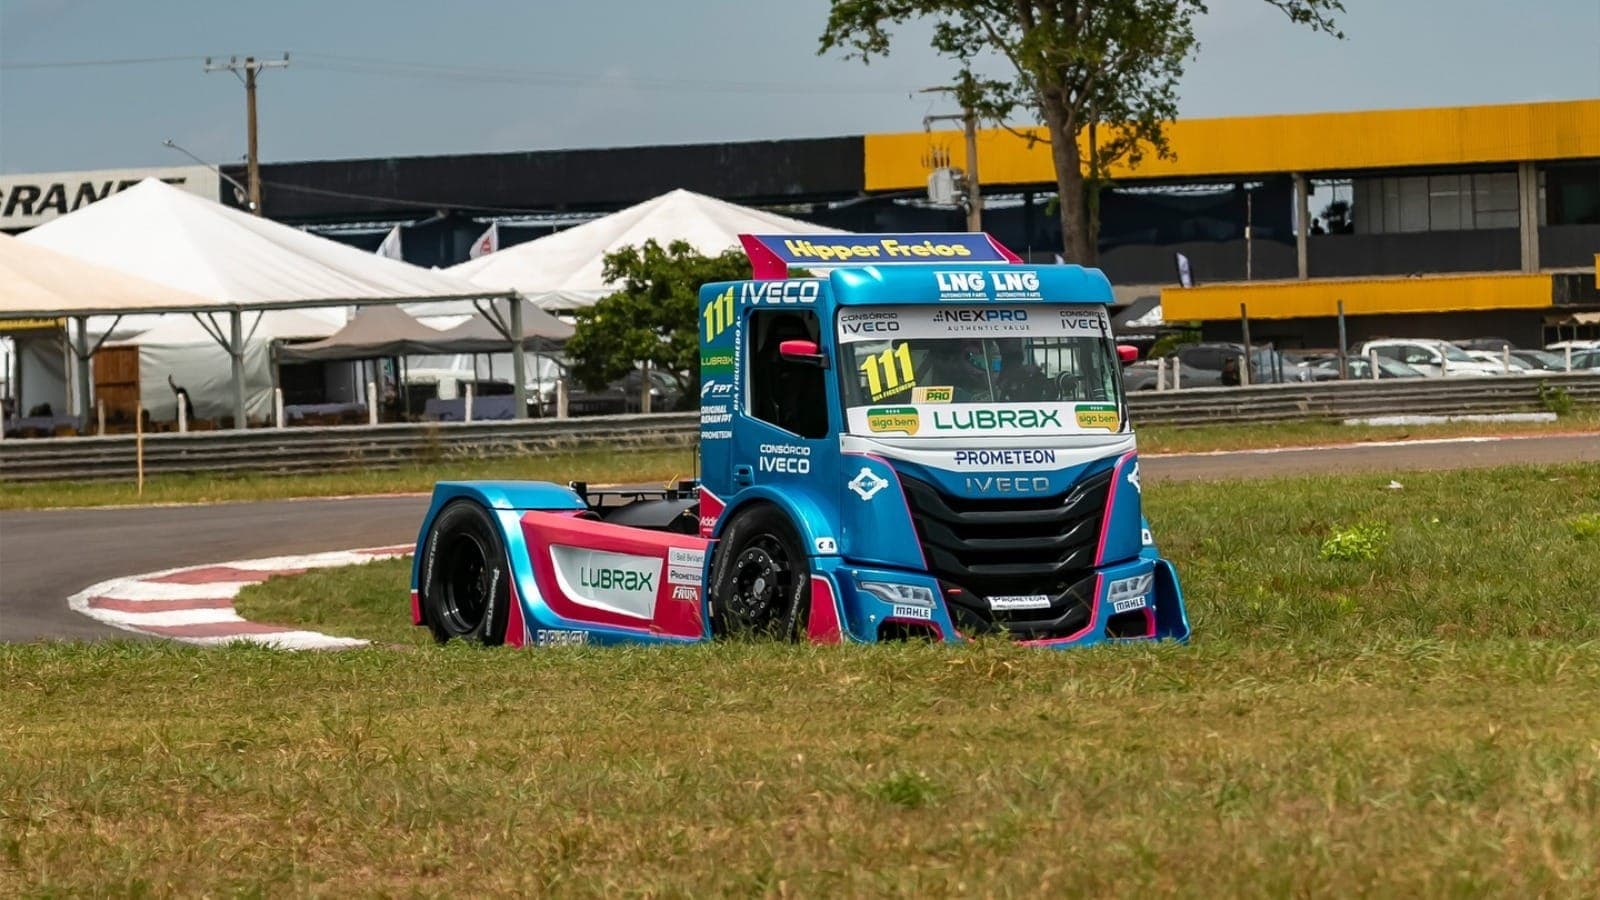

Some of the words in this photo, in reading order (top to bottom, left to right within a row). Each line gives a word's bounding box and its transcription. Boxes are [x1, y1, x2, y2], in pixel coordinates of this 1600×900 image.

[785, 239, 879, 260] Hipper
[881, 240, 971, 260] Freios
[938, 272, 986, 292] LNG
[991, 272, 1040, 292] LNG
[741, 281, 819, 305] IVECO
[703, 286, 734, 343] 111
[946, 310, 1028, 322] NEXPRO
[843, 321, 900, 334] IVECO
[1061, 319, 1108, 330] IVECO
[860, 342, 915, 397] 111
[712, 384, 733, 393] FPT
[926, 391, 950, 401] PRO
[871, 419, 893, 429] siga
[895, 418, 917, 427] bem
[1079, 415, 1098, 424] siga
[760, 443, 811, 456] CONSÓRCIO
[954, 450, 1055, 465] PROMETEON
[759, 456, 810, 474] IVECO
[965, 477, 1050, 493] IVECO
[1116, 597, 1144, 611] MAHLE
[895, 606, 930, 618] MAHLE
